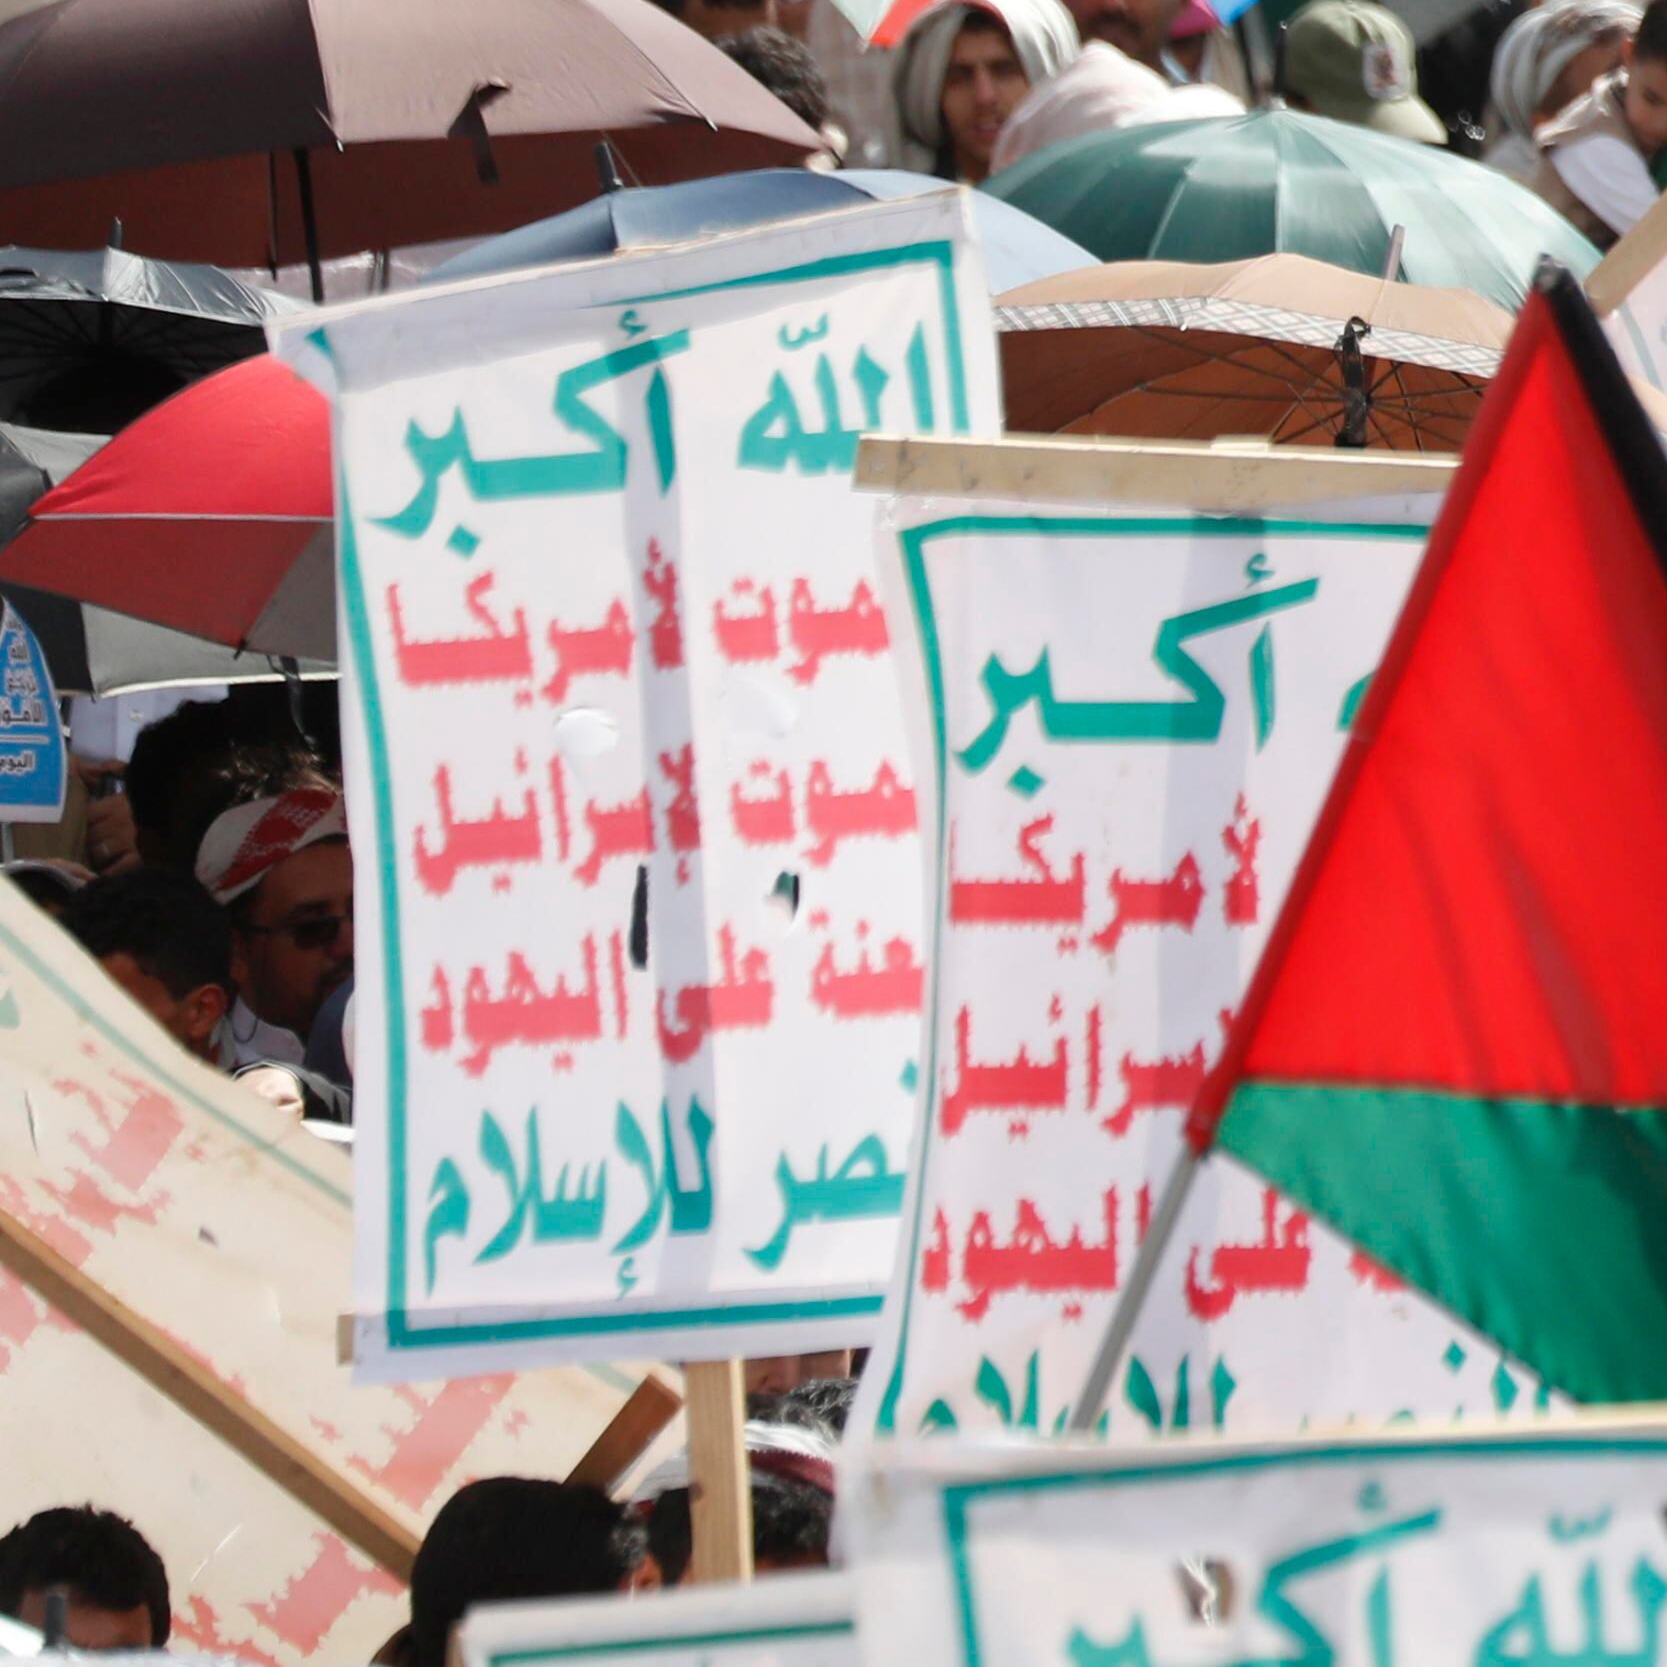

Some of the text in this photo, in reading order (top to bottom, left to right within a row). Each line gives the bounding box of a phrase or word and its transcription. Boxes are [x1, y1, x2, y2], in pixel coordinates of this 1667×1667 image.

[367, 310, 935, 556] الله أكبر
[388, 539, 684, 705] لأمريكا
[956, 554, 1318, 796] أكبر
[414, 743, 701, 895] لإسرائيل
[947, 792, 1263, 959] لأمريكا
[422, 931, 628, 1076] اليهود
[656, 926, 774, 1063] على
[424, 1094, 714, 1301] للإسلام
[922, 1183, 1152, 1322] اليهود
